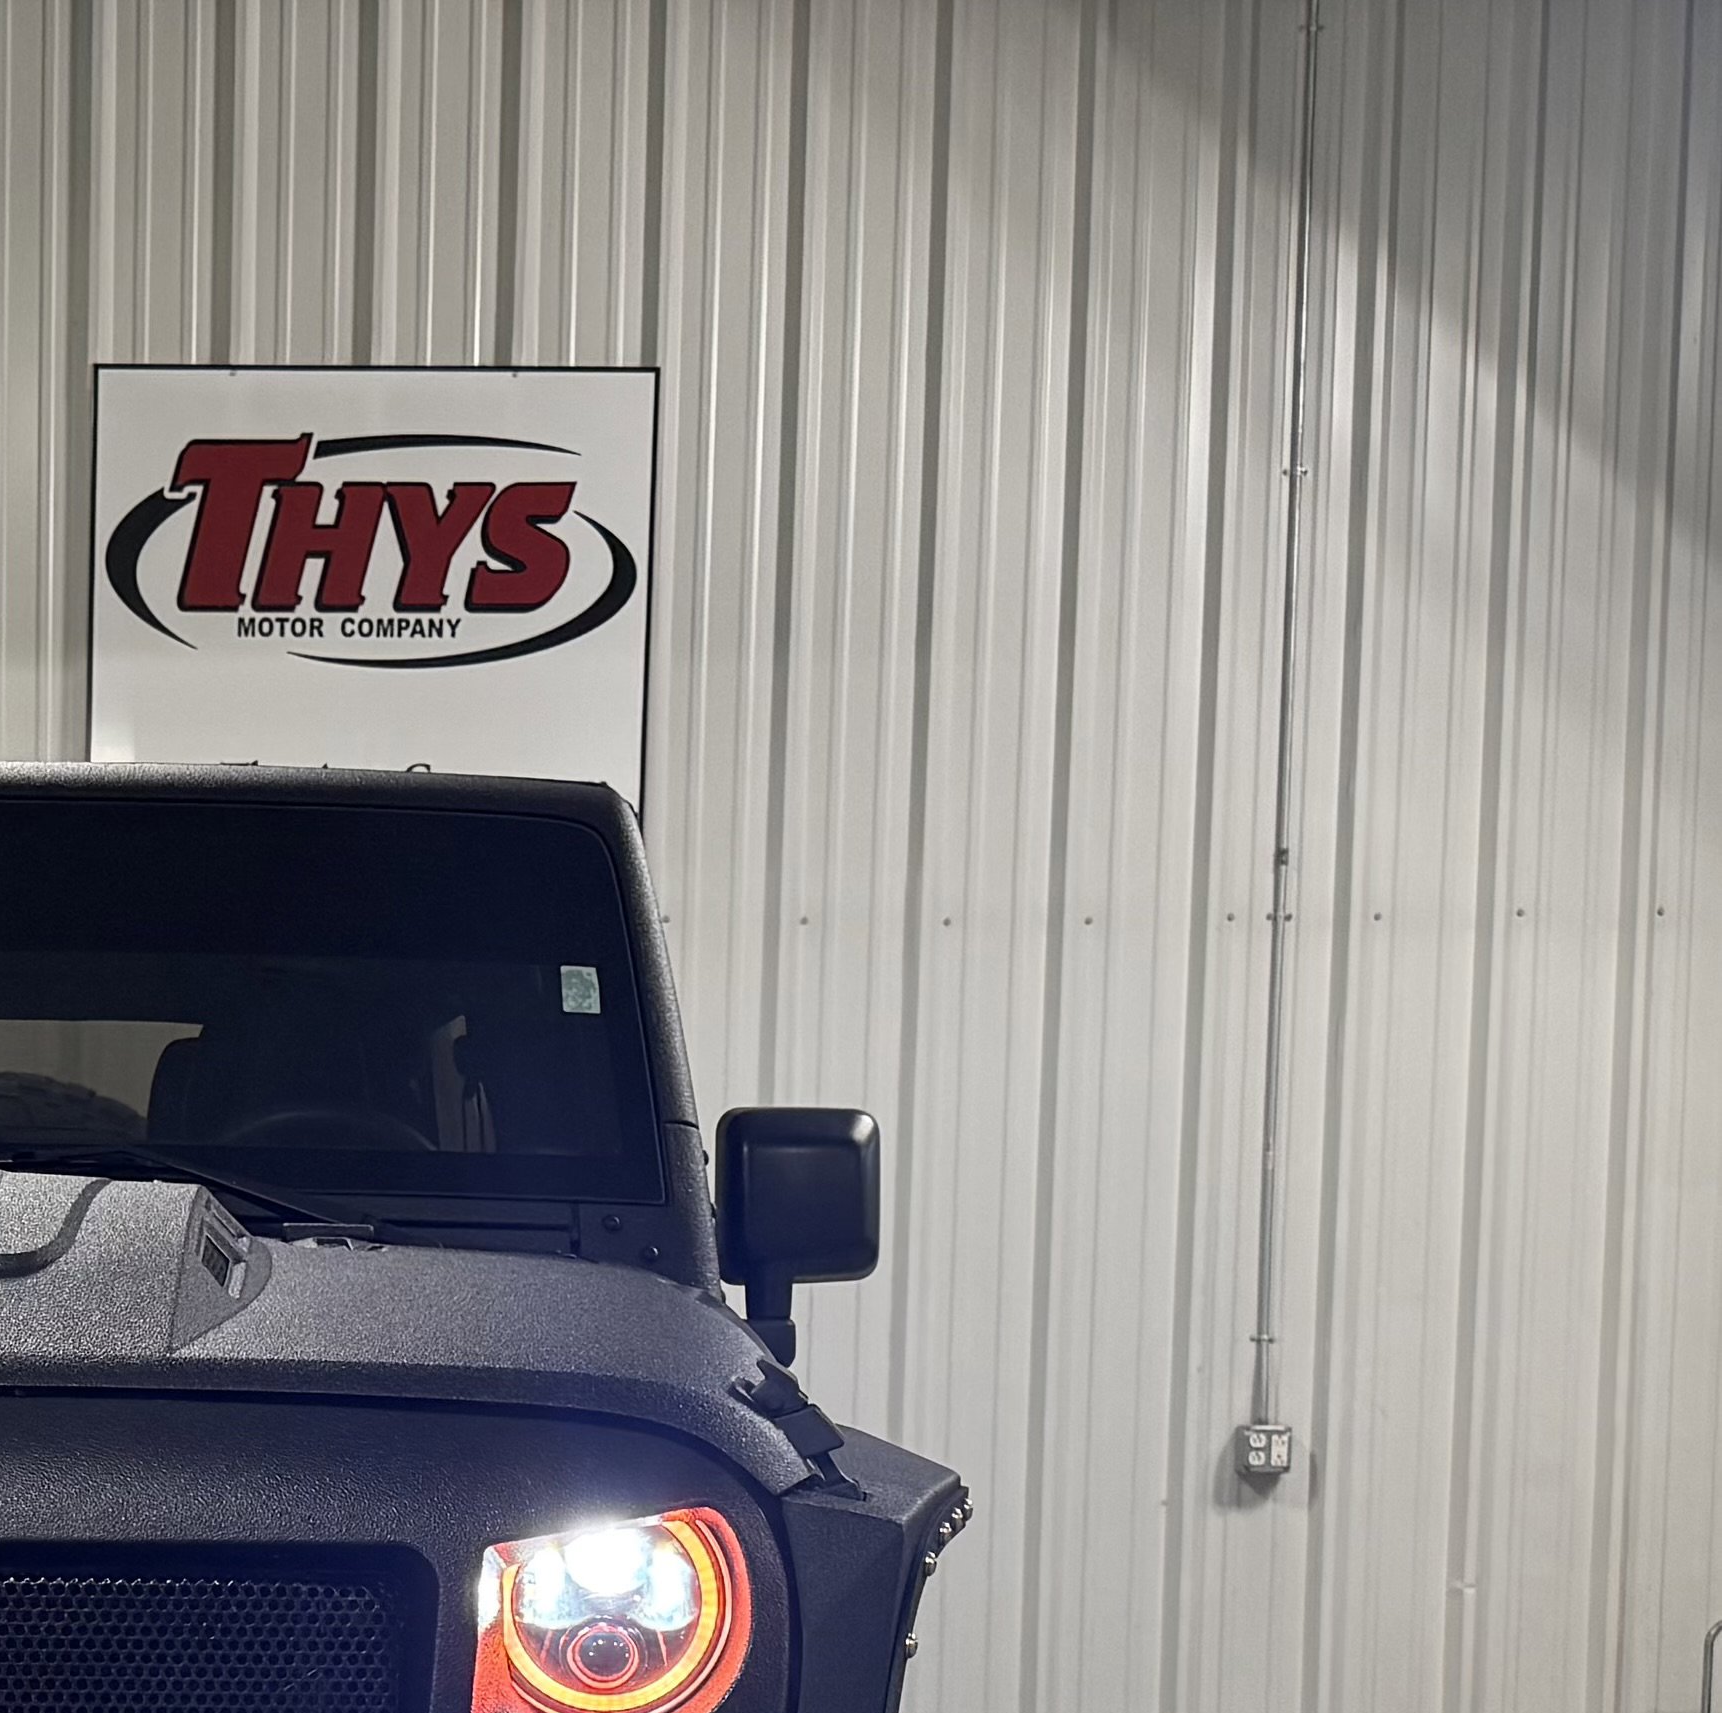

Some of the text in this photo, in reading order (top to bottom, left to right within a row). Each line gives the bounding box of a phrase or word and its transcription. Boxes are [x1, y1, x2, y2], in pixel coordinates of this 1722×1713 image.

[169, 432, 577, 613] THYS
[236, 617, 462, 639] MOTOR COMPANY
